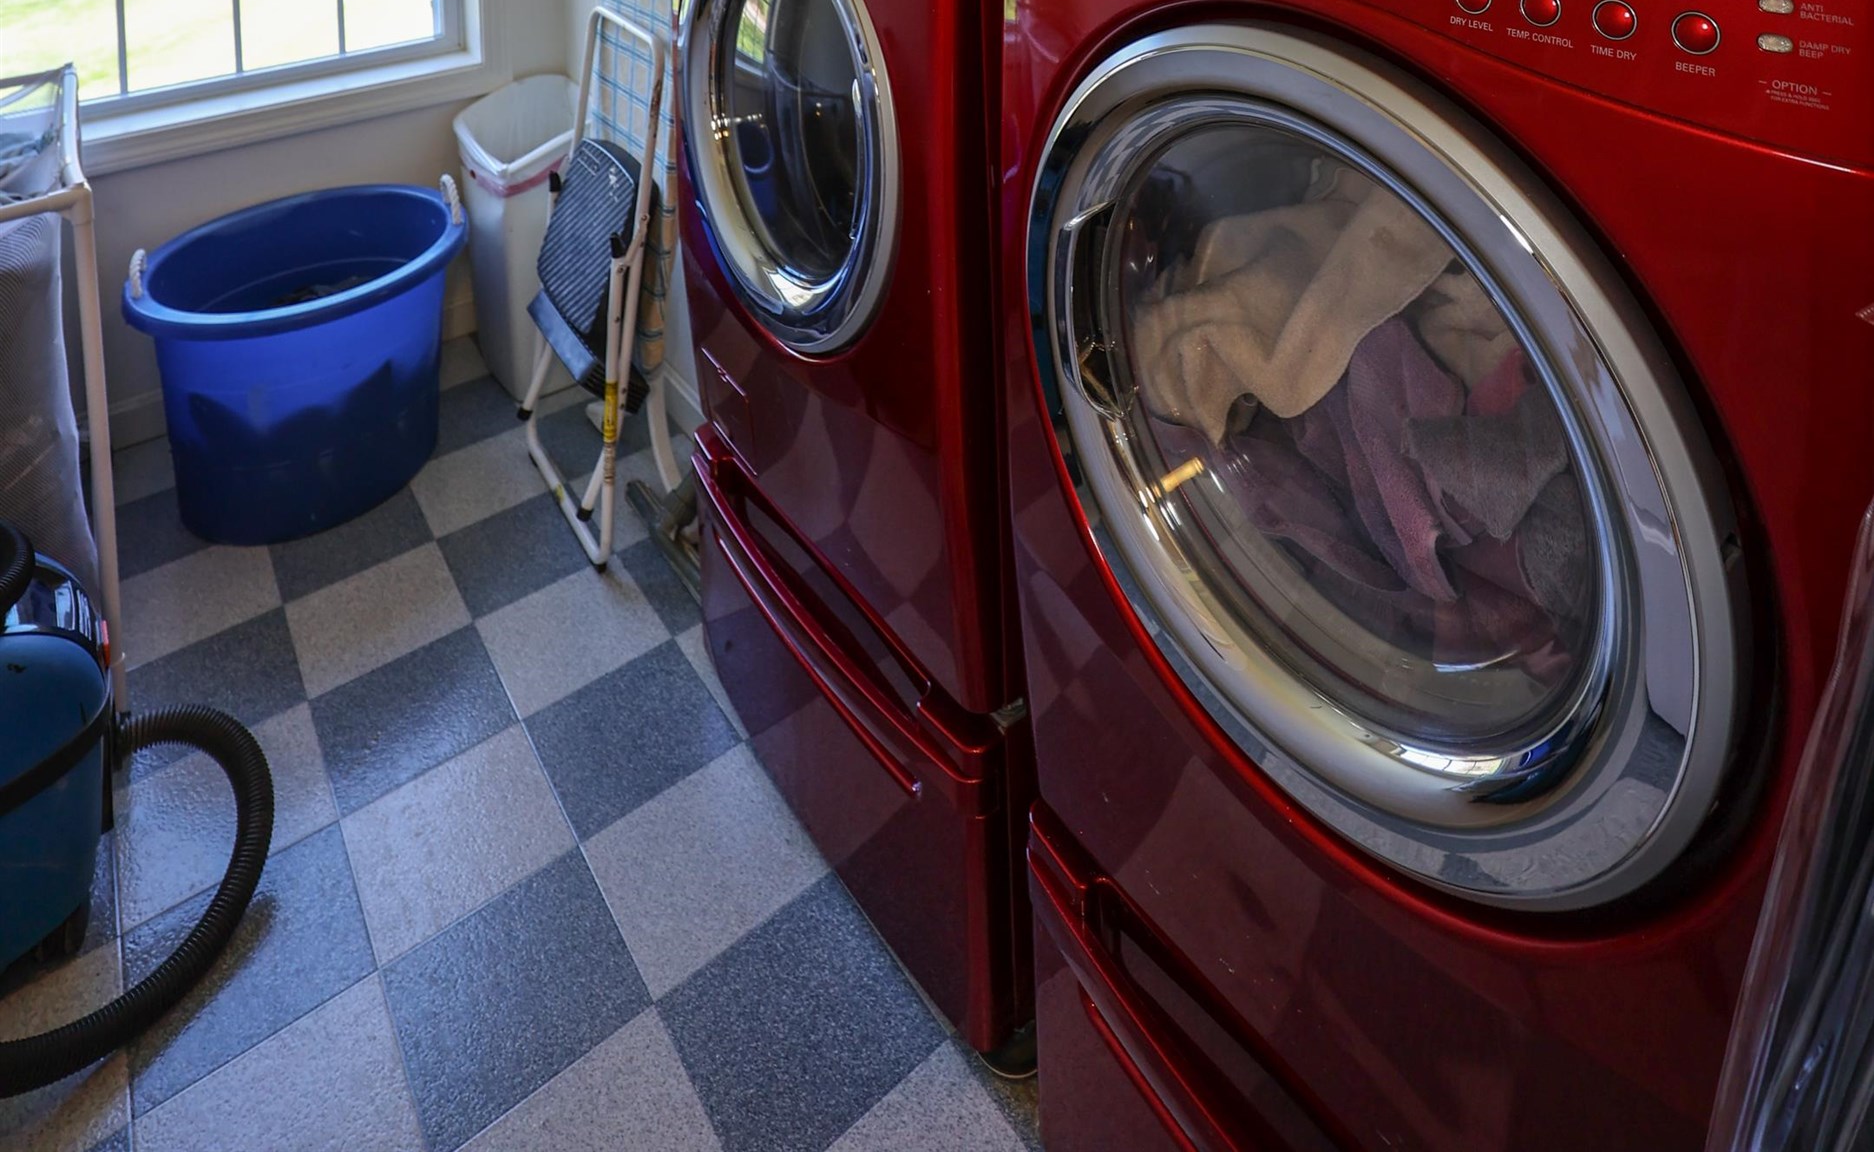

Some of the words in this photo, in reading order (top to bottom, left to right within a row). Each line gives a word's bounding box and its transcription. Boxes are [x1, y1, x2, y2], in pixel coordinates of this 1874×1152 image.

[1800, 3, 1823, 12] ANTI
[1450, 15, 1466, 26] DRY
[1468, 19, 1493, 32] LEVEL
[1800, 10, 1854, 26] BACTERIAL
[1506, 28, 1530, 40] TEMP.
[1532, 33, 1573, 48] CONTROL
[1590, 45, 1615, 58] TIME
[1616, 49, 1637, 61] DRY
[1799, 40, 1828, 51] DAMP
[1831, 45, 1850, 55] DRY
[1799, 49, 1824, 59] BEEP
[1675, 61, 1716, 77] BEEPER
[1772, 79, 1817, 95] OPTION
